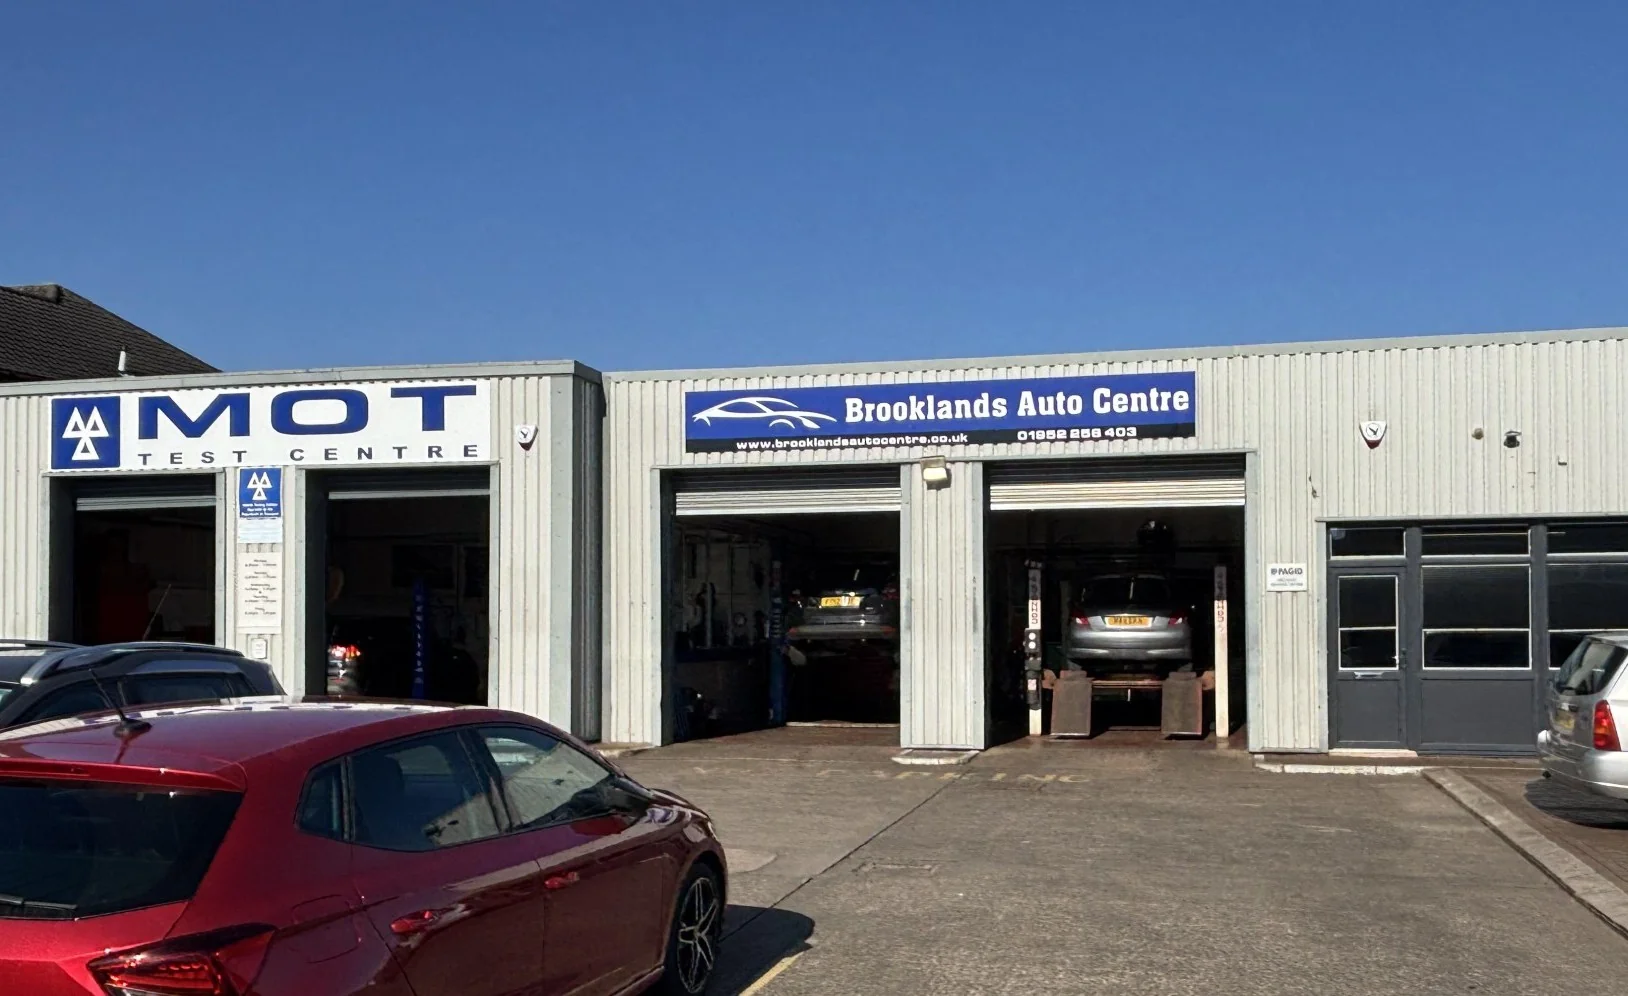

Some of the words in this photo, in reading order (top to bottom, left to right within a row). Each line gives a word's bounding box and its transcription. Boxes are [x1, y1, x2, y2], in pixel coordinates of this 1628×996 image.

[138, 385, 477, 440] MOT
[845, 392, 1008, 423] Brooklands
[1017, 390, 1083, 417] Auto
[1093, 387, 1190, 414] Centre
[736, 433, 969, 449] www.brooklandsautocentre.co.uk
[1017, 429, 1068, 441] 01952
[1104, 426, 1137, 437] 403
[138, 450, 247, 466] TEST
[289, 445, 478, 462] CENTRE
